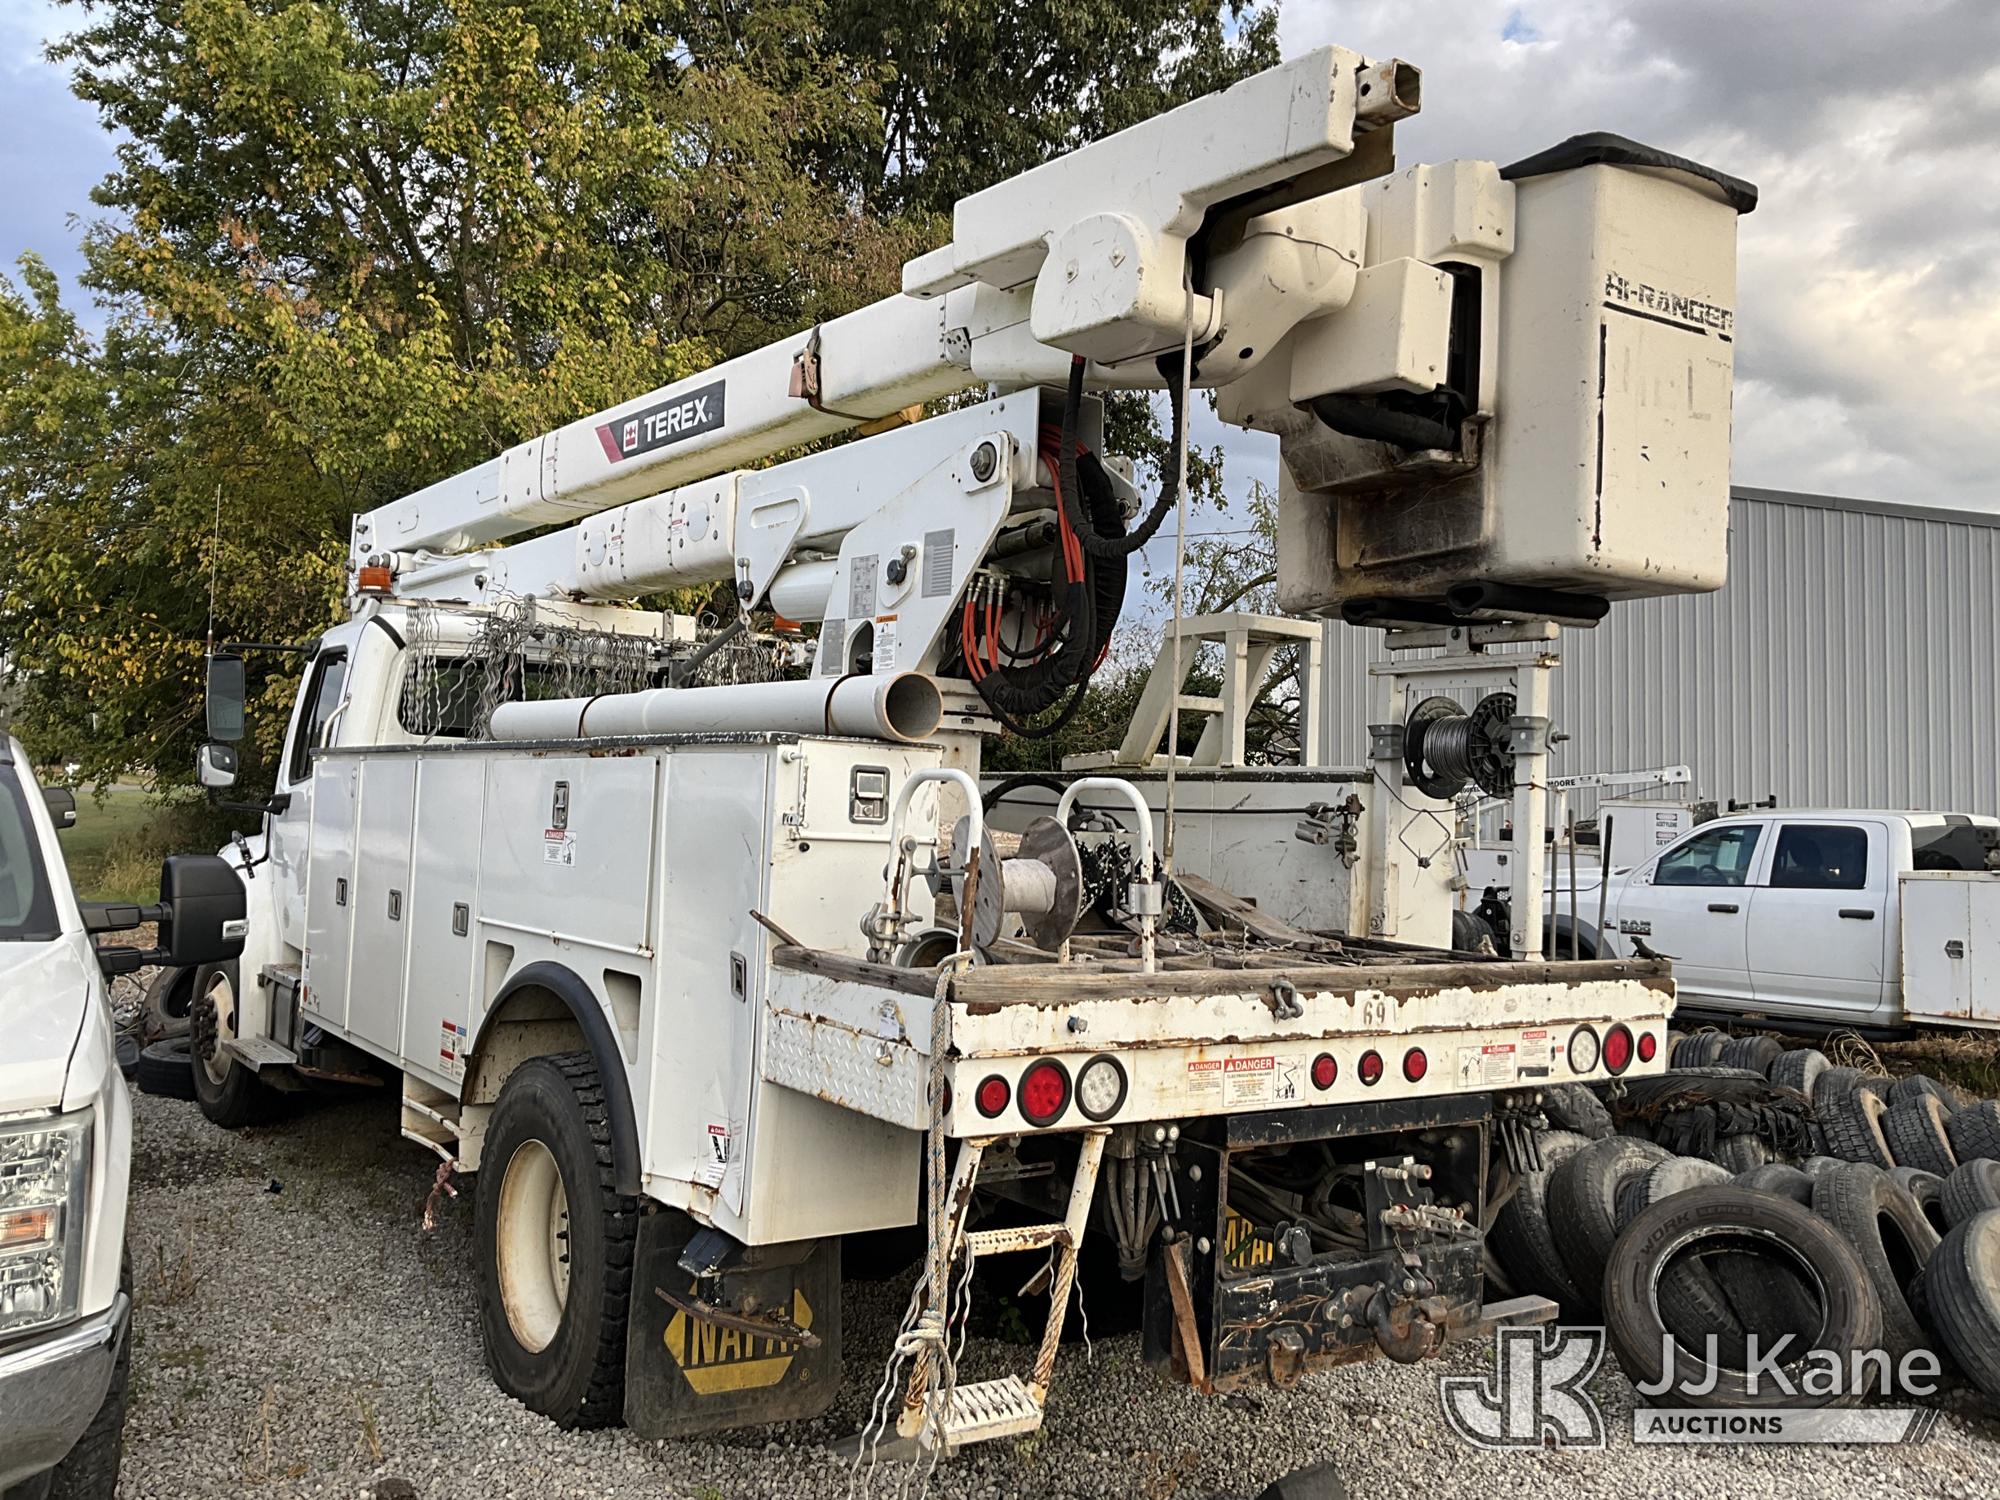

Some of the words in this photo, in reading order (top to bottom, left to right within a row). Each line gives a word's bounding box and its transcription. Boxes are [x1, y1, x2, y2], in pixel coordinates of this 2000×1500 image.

[1605, 271, 1733, 330] HI-RANGER
[644, 395, 708, 442] TEREX
[1195, 1062, 1220, 1070] DANGER
[1235, 1059, 1272, 1071] DANGER
[1639, 1211, 1690, 1256] WORK
